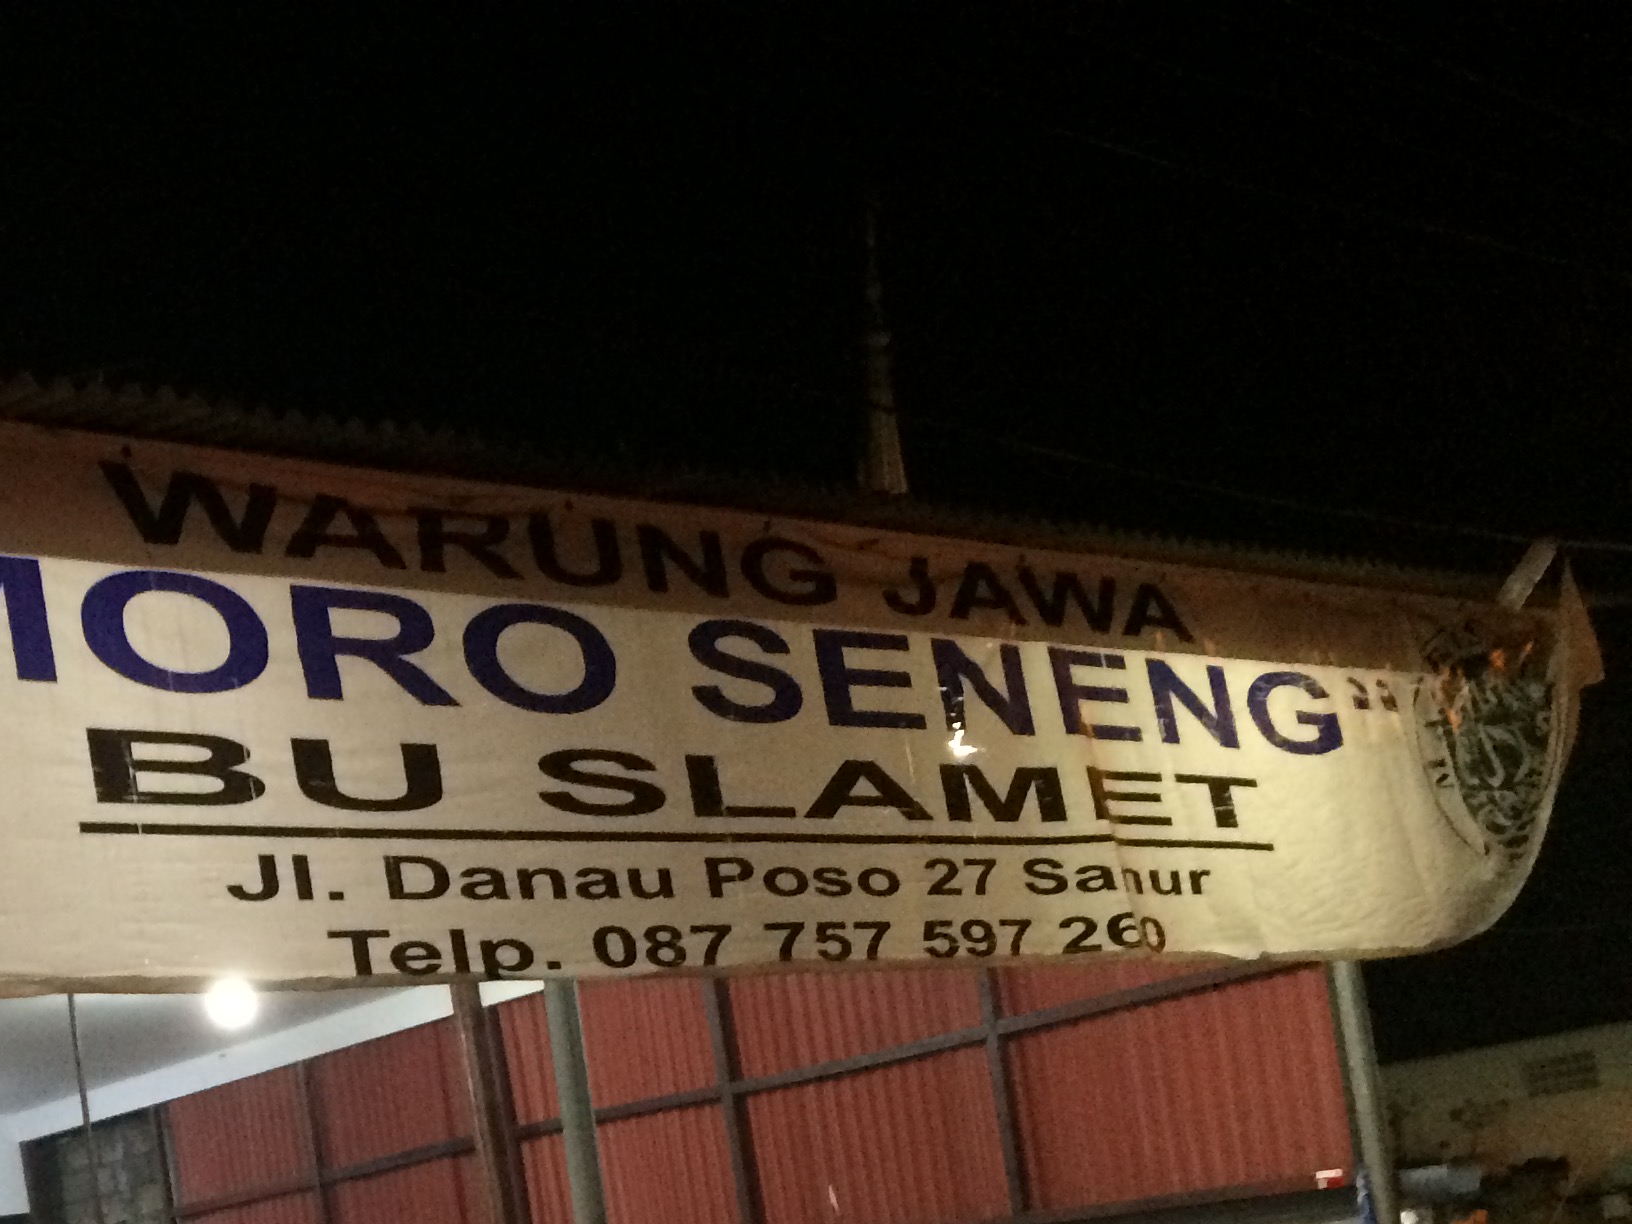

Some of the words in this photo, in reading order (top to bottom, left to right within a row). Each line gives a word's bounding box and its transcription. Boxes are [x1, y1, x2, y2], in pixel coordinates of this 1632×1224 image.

[97, 459, 838, 606] WARUNG
[882, 555, 1194, 643] JAWA
[86, 727, 443, 812] BU
[538, 747, 1258, 829] SLAMET
[226, 854, 346, 901] Jl.
[383, 855, 675, 901] Danau
[704, 857, 901, 898] Poso
[925, 857, 998, 897] 27
[1022, 857, 1212, 897] Sanur
[326, 929, 563, 979] Telp.
[592, 923, 734, 969] 087
[764, 920, 892, 962] 757
[923, 917, 1033, 959] 597
[1059, 910, 1168, 955] 260
